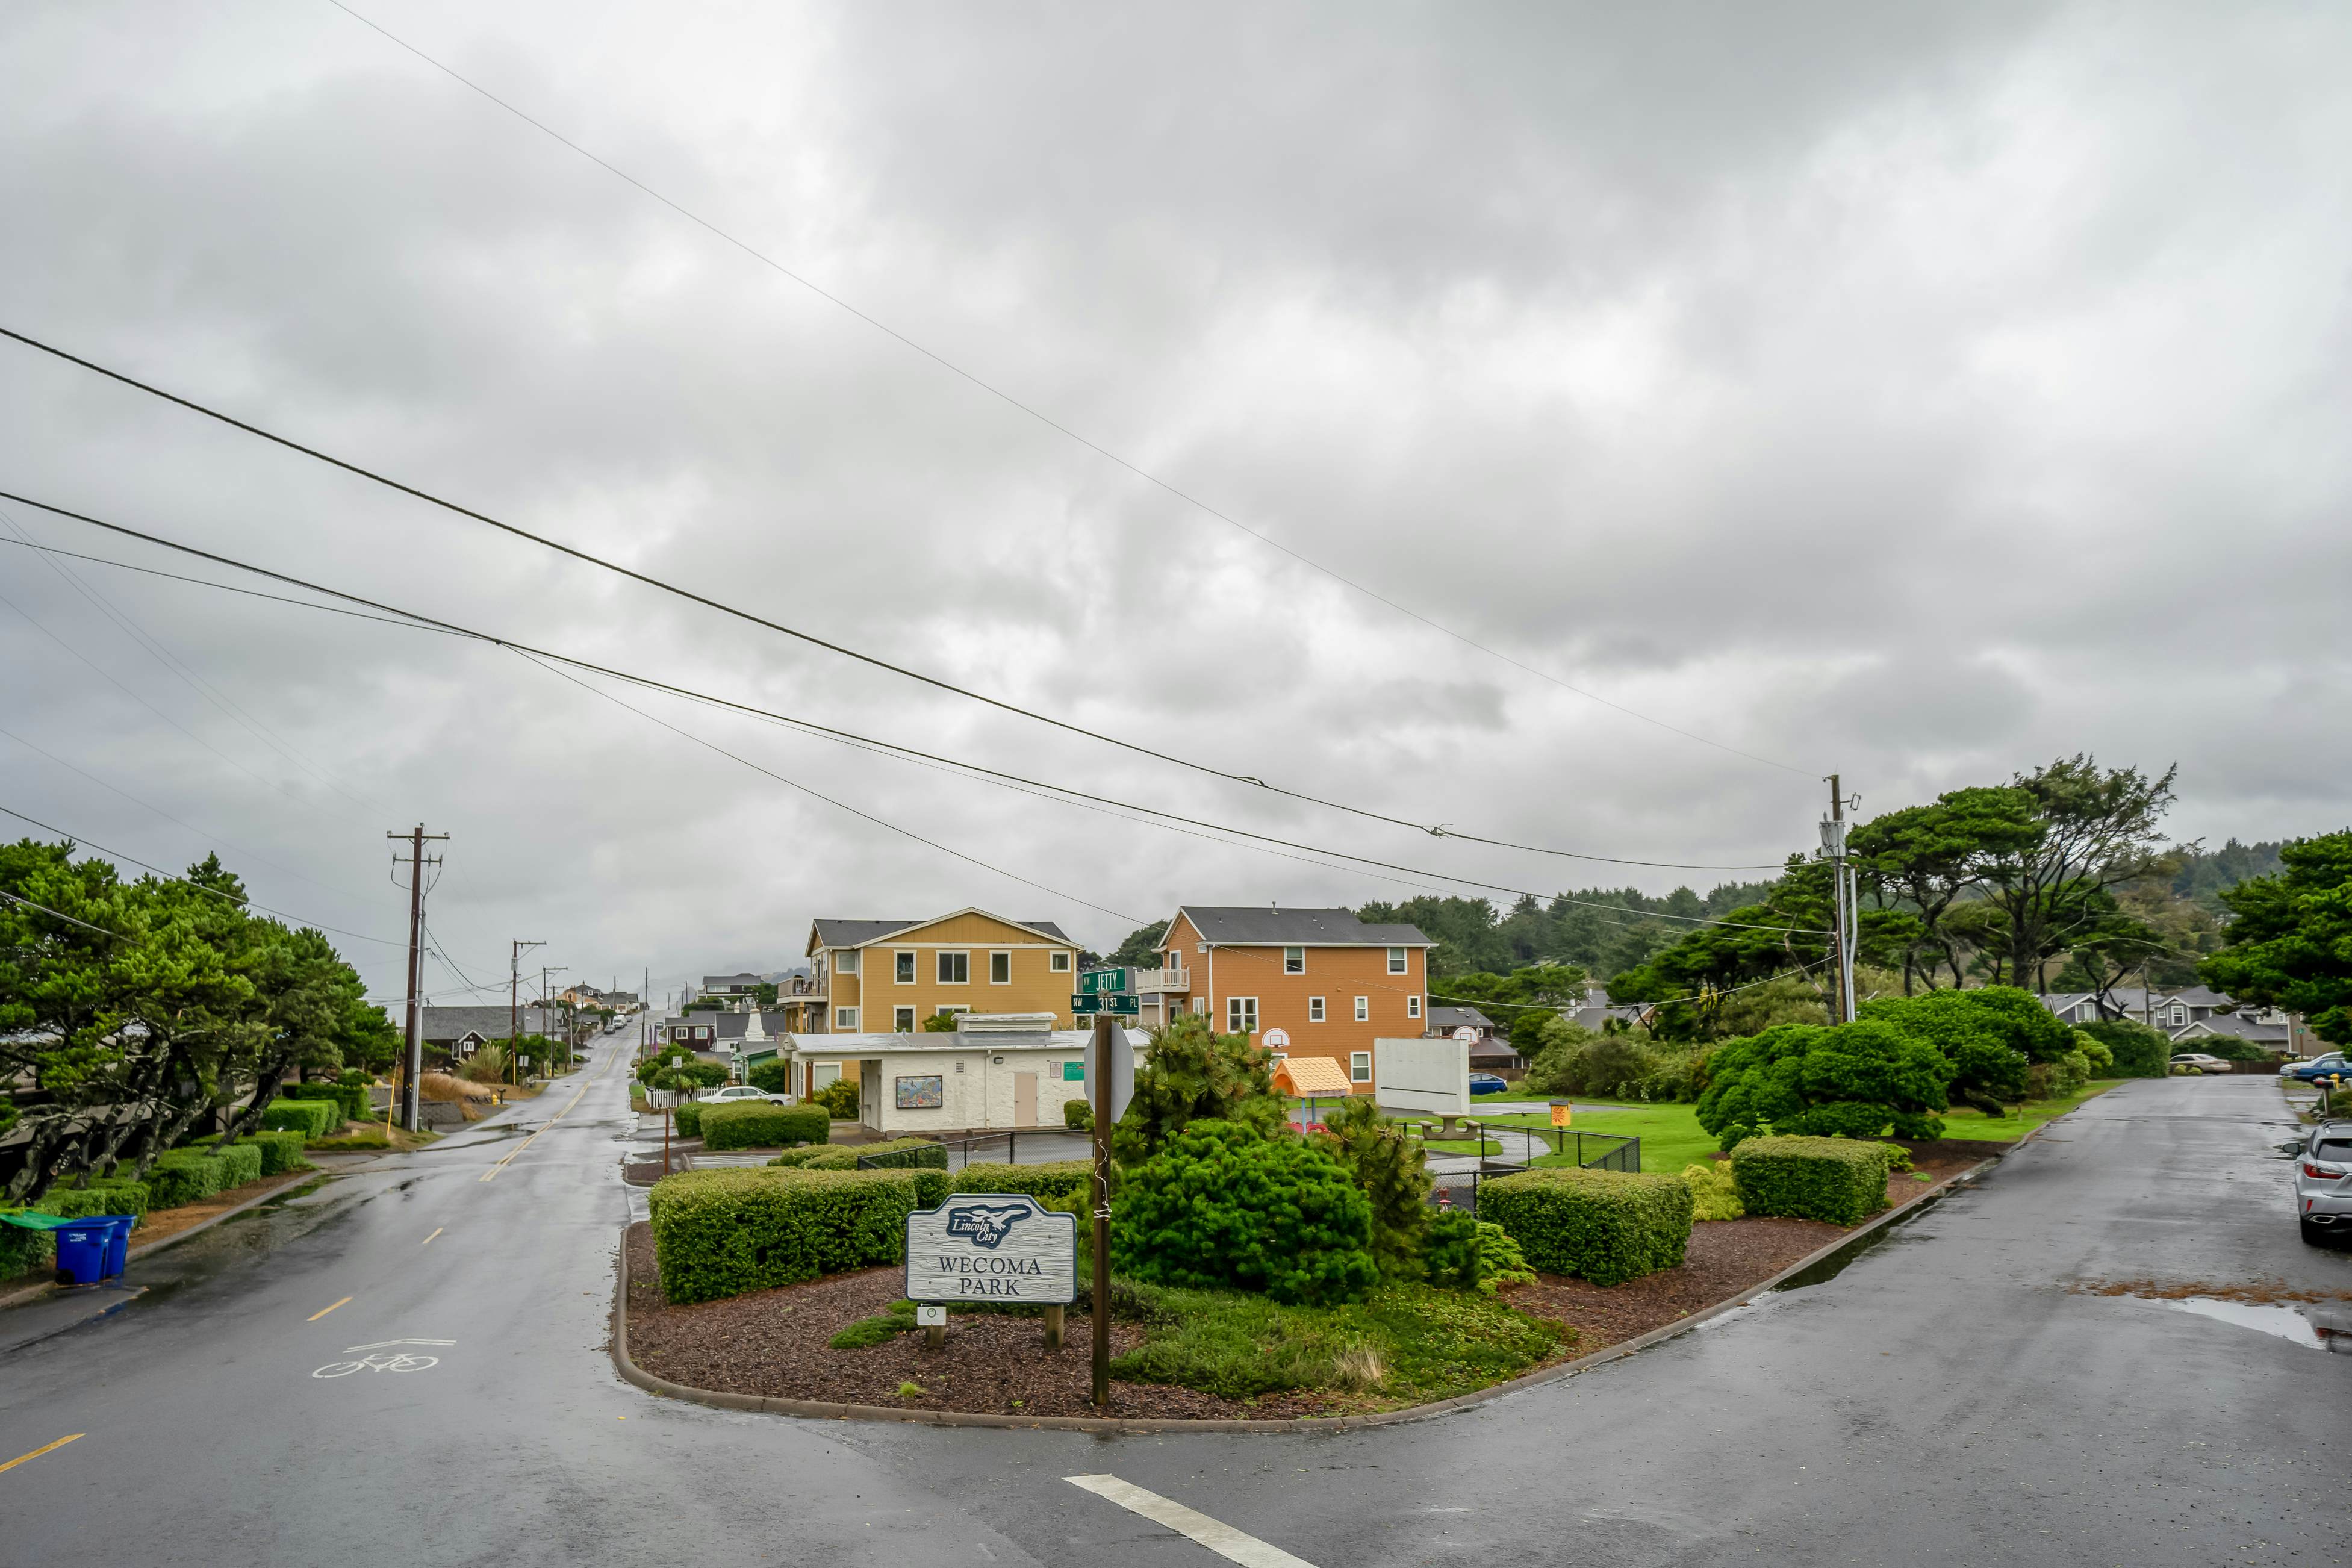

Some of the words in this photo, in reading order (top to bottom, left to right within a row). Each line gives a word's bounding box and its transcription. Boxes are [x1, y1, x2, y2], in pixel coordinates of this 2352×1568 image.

[1083, 977, 1090, 986] NW
[1095, 972, 1117, 991] JETTY
[1130, 998, 1137, 1007] PL
[952, 1219, 990, 1232] Lincoln
[976, 1230, 998, 1243] City
[939, 1257, 1042, 1275] WECOMA
[959, 1278, 1021, 1295] PARK
